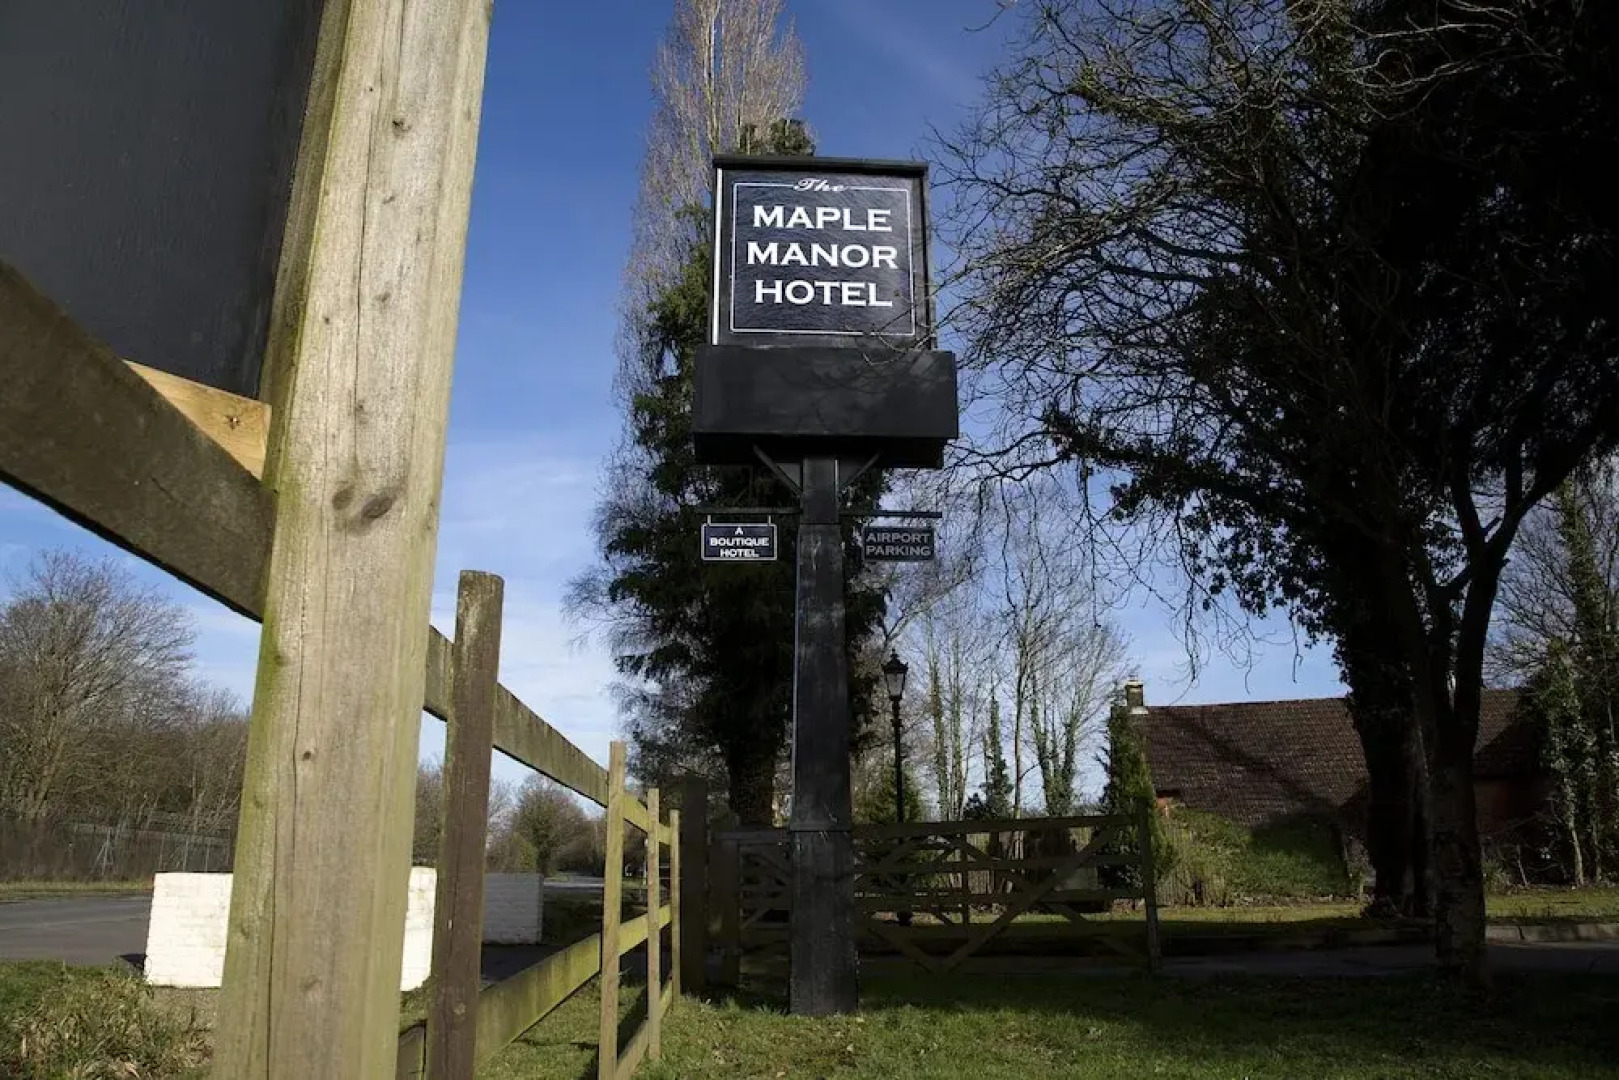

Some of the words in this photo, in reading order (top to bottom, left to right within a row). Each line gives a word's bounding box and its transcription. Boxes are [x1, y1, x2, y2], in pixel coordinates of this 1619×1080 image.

[793, 177, 848, 192] The
[752, 205, 893, 232] MAPLE
[747, 241, 898, 270] MANOR
[755, 279, 893, 307] HOTEL
[734, 527, 744, 535] A
[710, 537, 769, 546] BOUTIQUE
[866, 532, 931, 543] AIRPORT
[719, 548, 759, 557] HOTEL
[865, 545, 932, 557] PARKING
